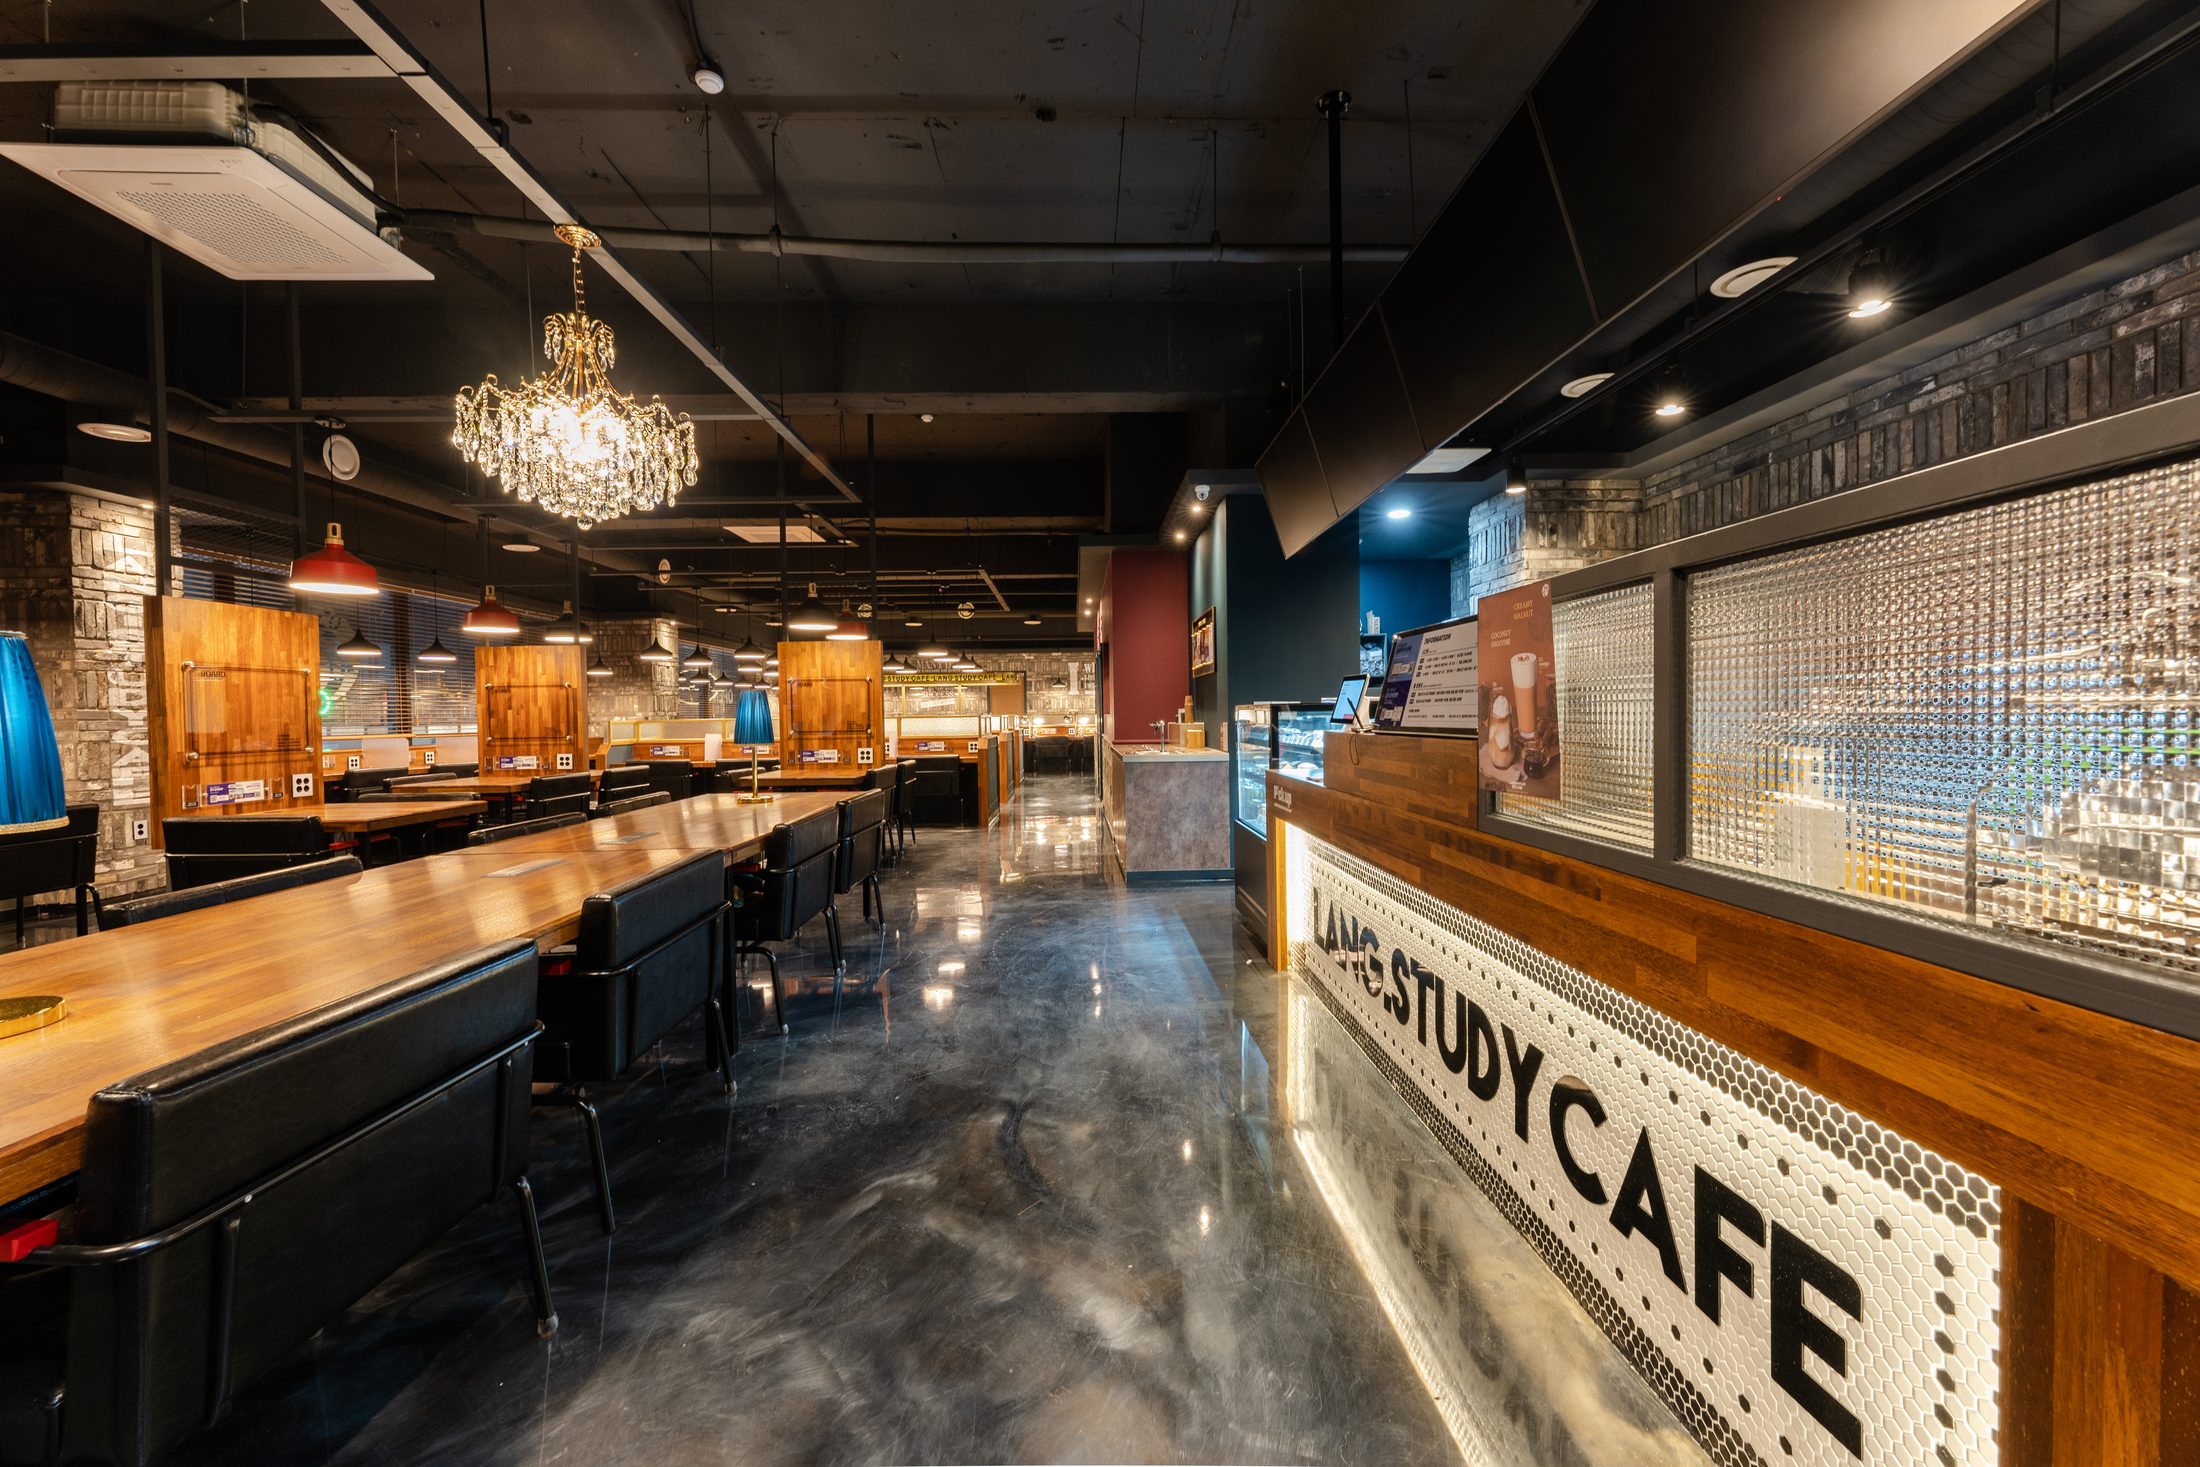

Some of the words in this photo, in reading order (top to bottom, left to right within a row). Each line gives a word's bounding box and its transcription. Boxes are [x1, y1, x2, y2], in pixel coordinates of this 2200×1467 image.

[1513, 600, 1534, 610] CREAMY
[1513, 610, 1535, 620] WALNUT
[1424, 633, 1452, 645] INFORMATION
[1490, 630, 1512, 639] COCONUT
[954, 674, 976, 682] STUDY
[1549, 1075, 1864, 1461] CAFE
